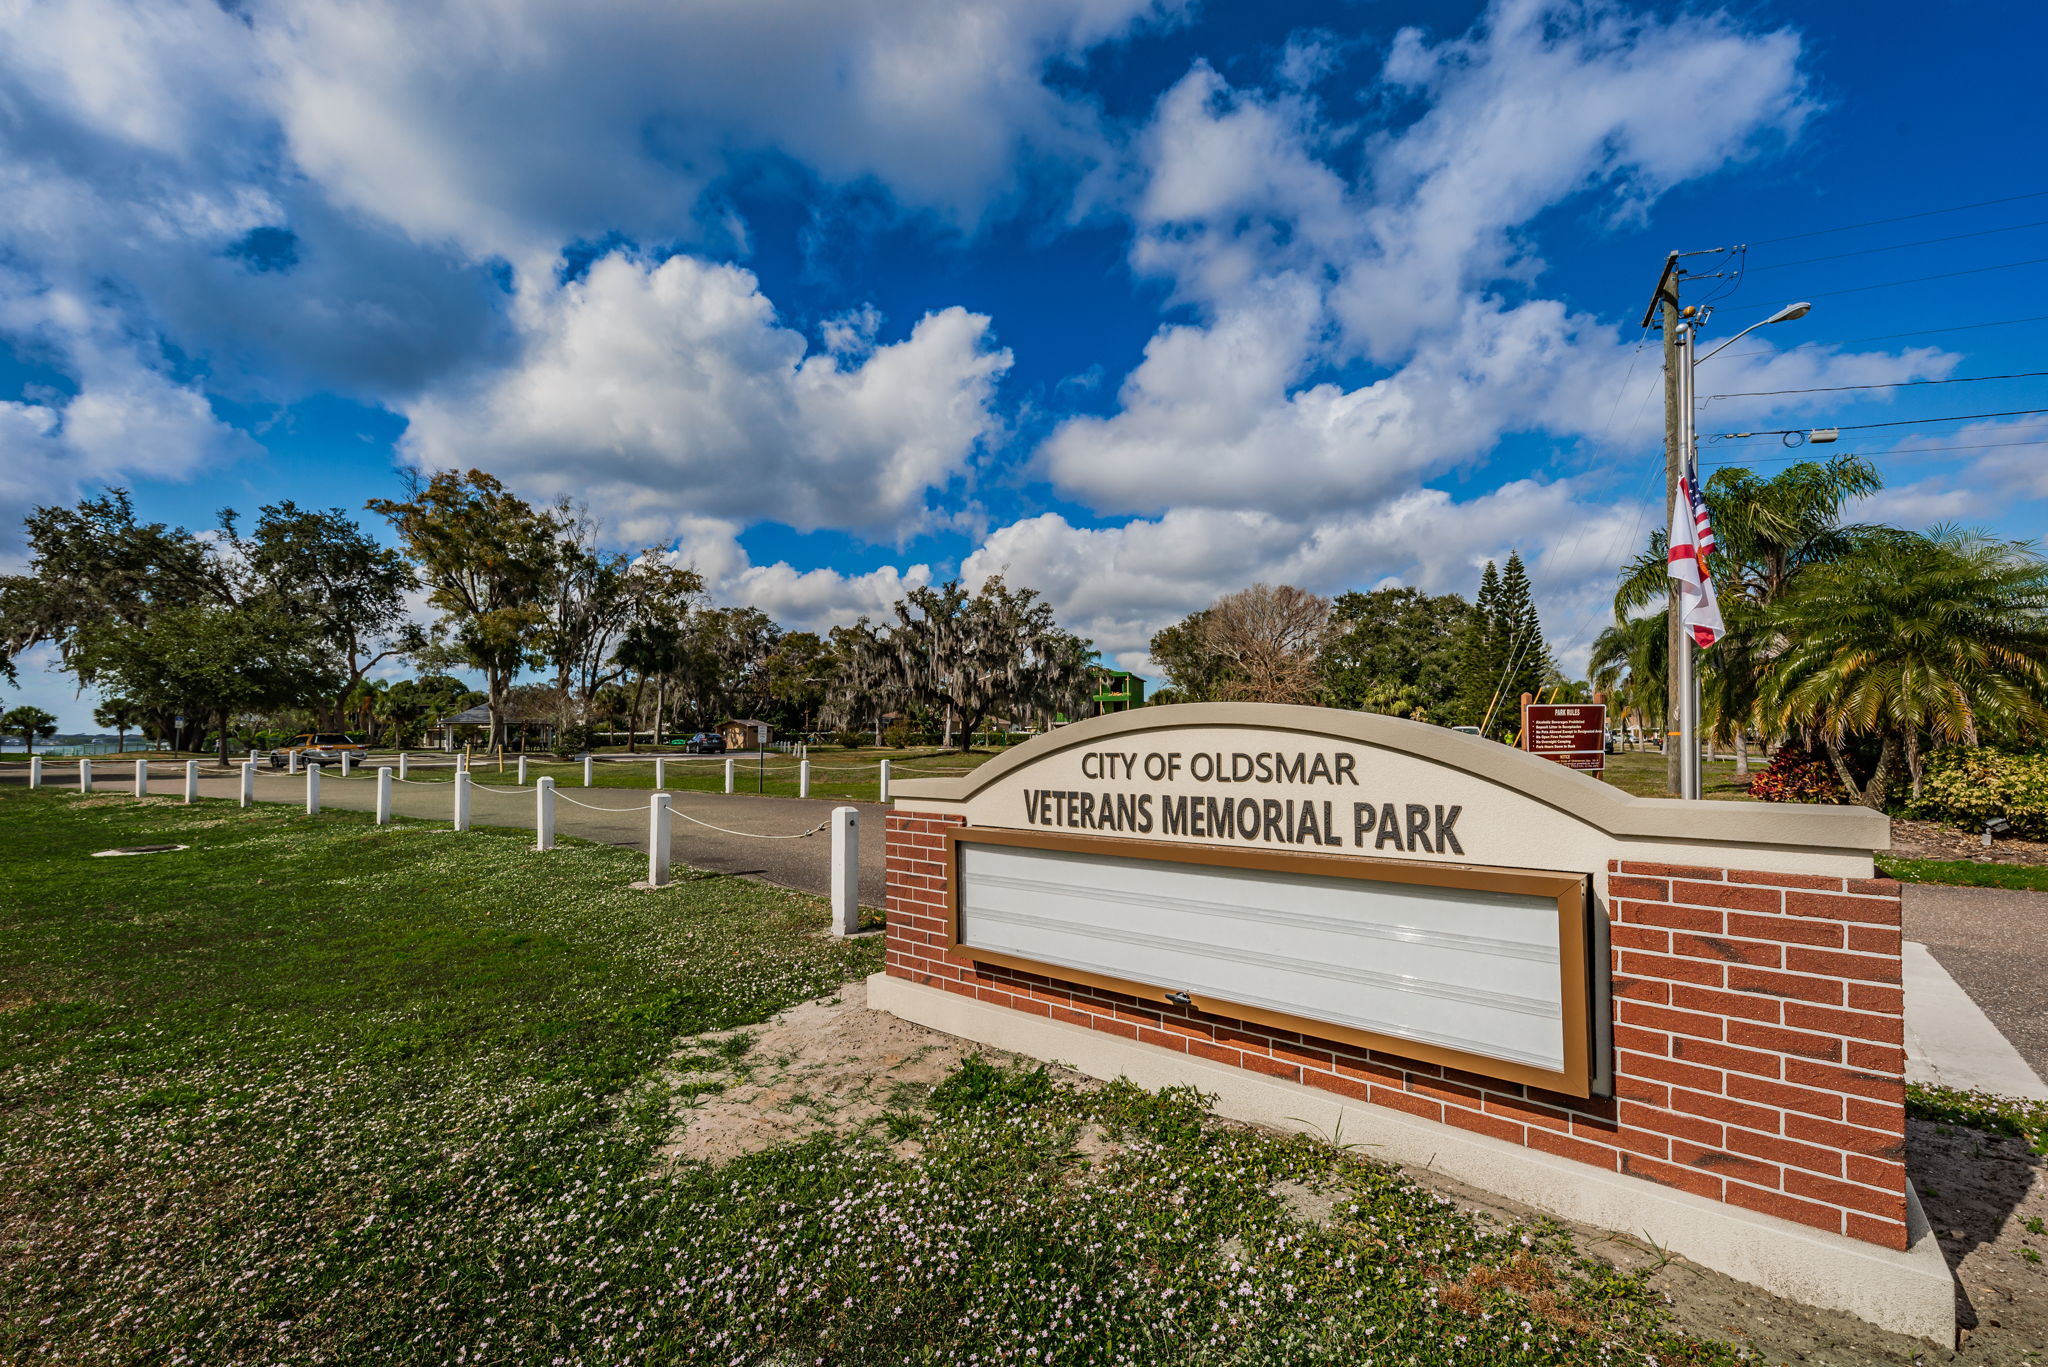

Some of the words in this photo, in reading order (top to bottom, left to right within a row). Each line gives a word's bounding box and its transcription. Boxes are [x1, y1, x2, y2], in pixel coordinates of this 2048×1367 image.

[1554, 708, 1566, 716] PARK
[1566, 708, 1580, 716] RULES
[1081, 752, 1138, 780] CITY
[1143, 752, 1182, 781] OF
[1190, 752, 1360, 786] OLDSMAR
[1023, 789, 1153, 834] VETERANS
[1162, 795, 1343, 847] MEMORIAL
[1353, 801, 1466, 856] PARK
